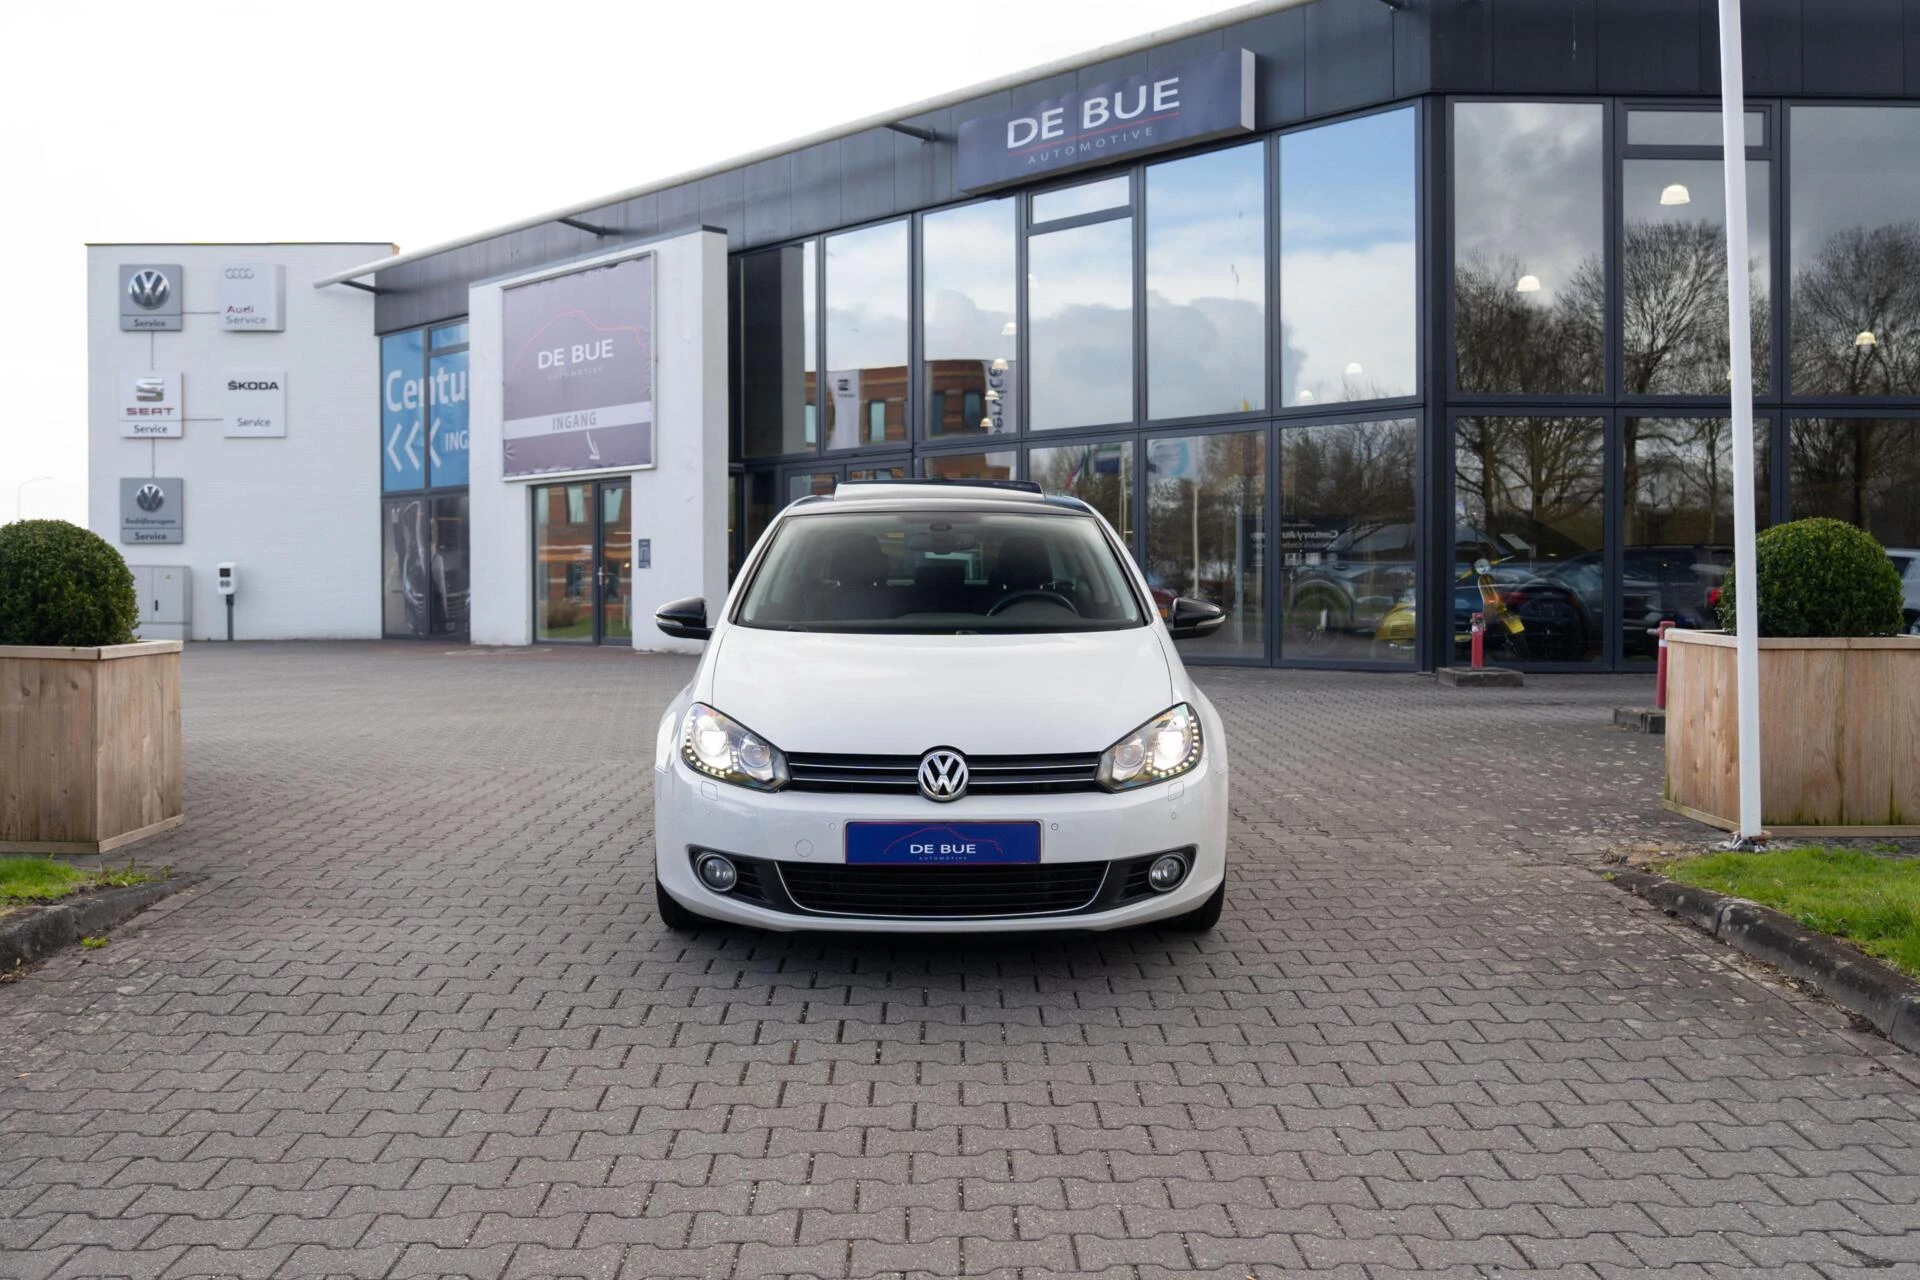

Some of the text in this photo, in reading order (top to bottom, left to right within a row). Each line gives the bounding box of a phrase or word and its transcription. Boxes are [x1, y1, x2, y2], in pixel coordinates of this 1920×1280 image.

[1007, 77, 1180, 149] DE BUE
[1027, 126, 1154, 165] AUTOMOTIVE
[226, 305, 254, 314] Audi
[133, 319, 167, 328] Service
[225, 315, 267, 325] Service
[538, 339, 614, 370] DE BUE
[228, 379, 279, 391] ŠKODA
[386, 366, 467, 413] Centu
[126, 407, 174, 416] SEAT
[237, 417, 271, 427] Service
[552, 411, 597, 431] INGANG
[133, 424, 168, 434] Service
[444, 430, 470, 452] ING
[134, 531, 167, 541] Service
[910, 844, 976, 854] DE BUE
